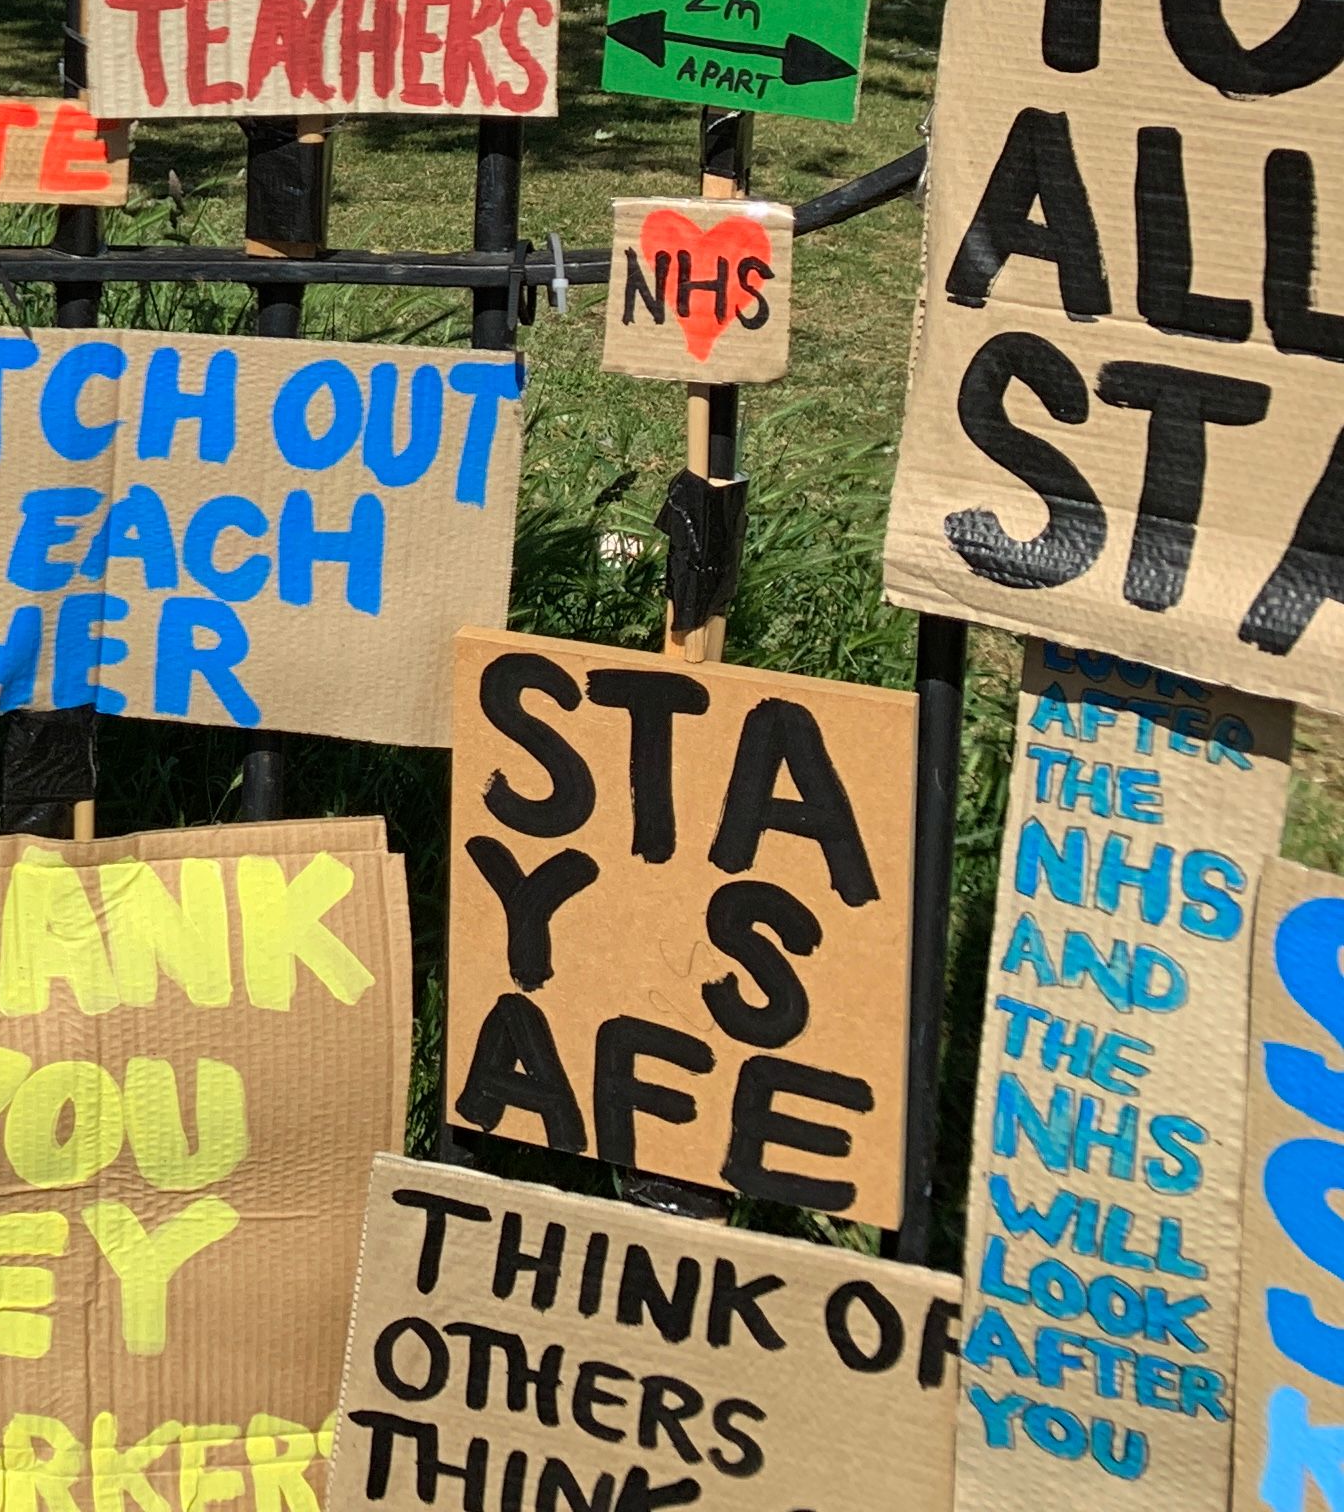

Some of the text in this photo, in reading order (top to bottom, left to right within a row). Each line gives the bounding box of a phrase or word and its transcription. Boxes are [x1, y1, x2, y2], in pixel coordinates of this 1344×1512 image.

[677, 54, 782, 100] APART
[620, 245, 776, 331] NHS
[272, 357, 526, 509] OUT
[6, 482, 388, 618] EACH
[479, 650, 880, 909] STA
[1026, 742, 1166, 827] THE
[1028, 681, 1255, 771] AFTER
[1013, 815, 1247, 943] NHS
[1000, 911, 1191, 1015] AND
[453, 991, 876, 1213] AFE
[994, 995, 1156, 1098] THE
[991, 1072, 1210, 1196] NHS
[988, 1173, 1209, 1281] WILL
[390, 1188, 962, 1391] THINK OF
[978, 1233, 1212, 1354] LOOK
[371, 1314, 768, 1479] OTHERS
[960, 1305, 1230, 1423] AFTER
[965, 1382, 1150, 1482] YOU
